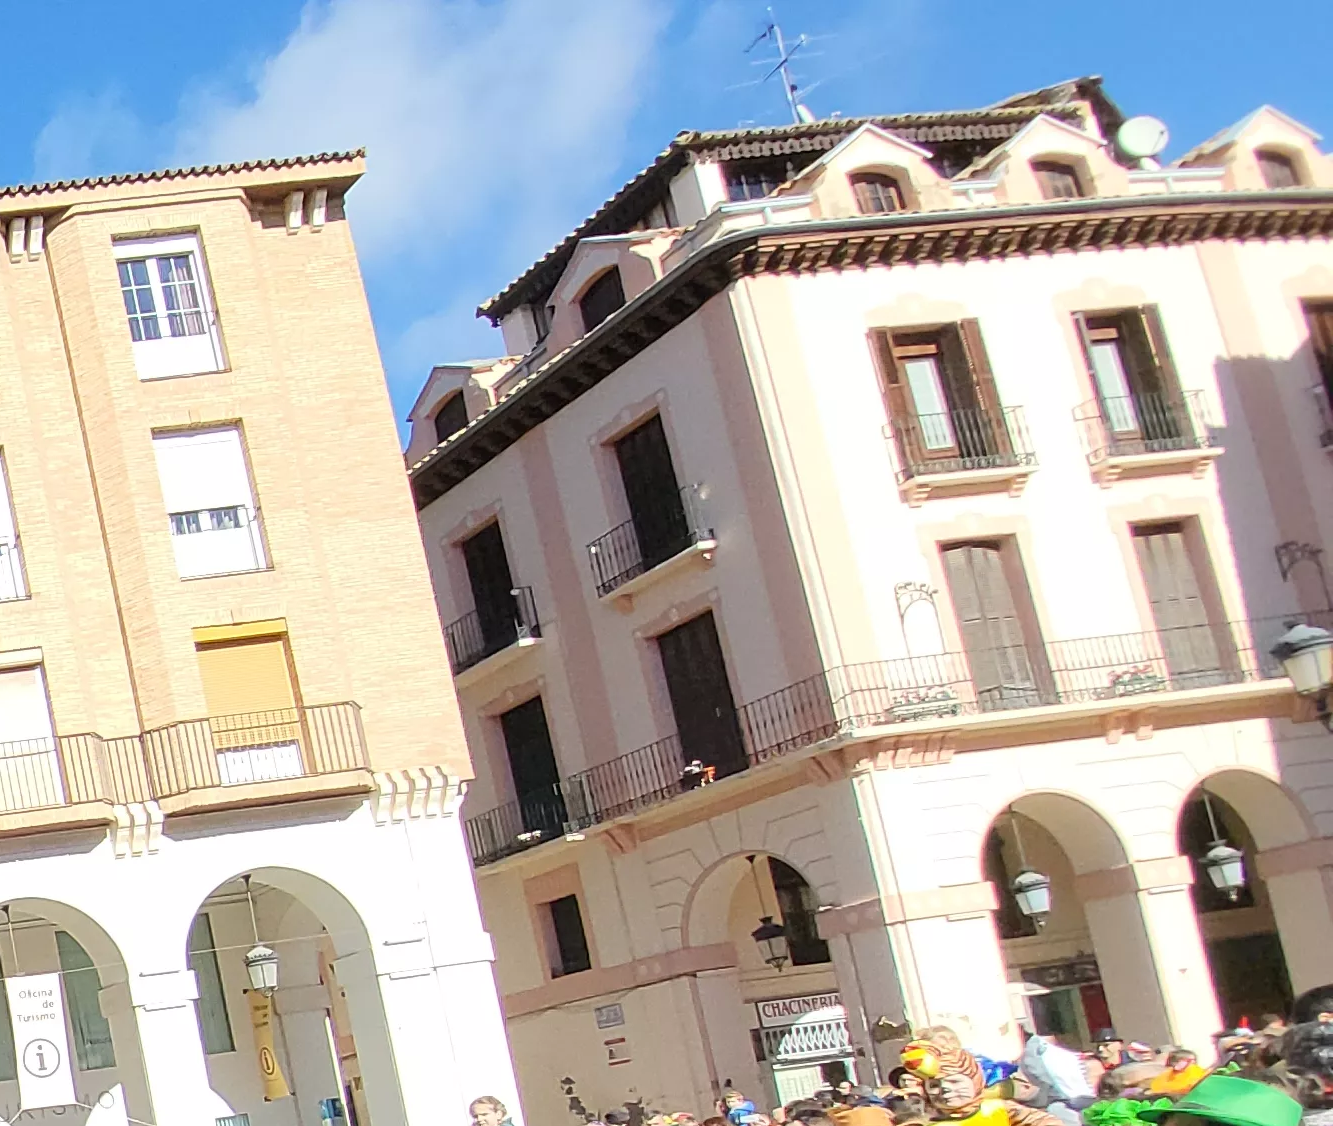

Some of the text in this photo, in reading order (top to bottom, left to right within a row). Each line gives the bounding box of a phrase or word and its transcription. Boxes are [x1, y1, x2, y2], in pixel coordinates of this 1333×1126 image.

[18, 989, 53, 999] Oficina
[42, 1000, 54, 1008] de
[761, 994, 843, 1018] CHACINERIA
[16, 1013, 56, 1022] Turismo
